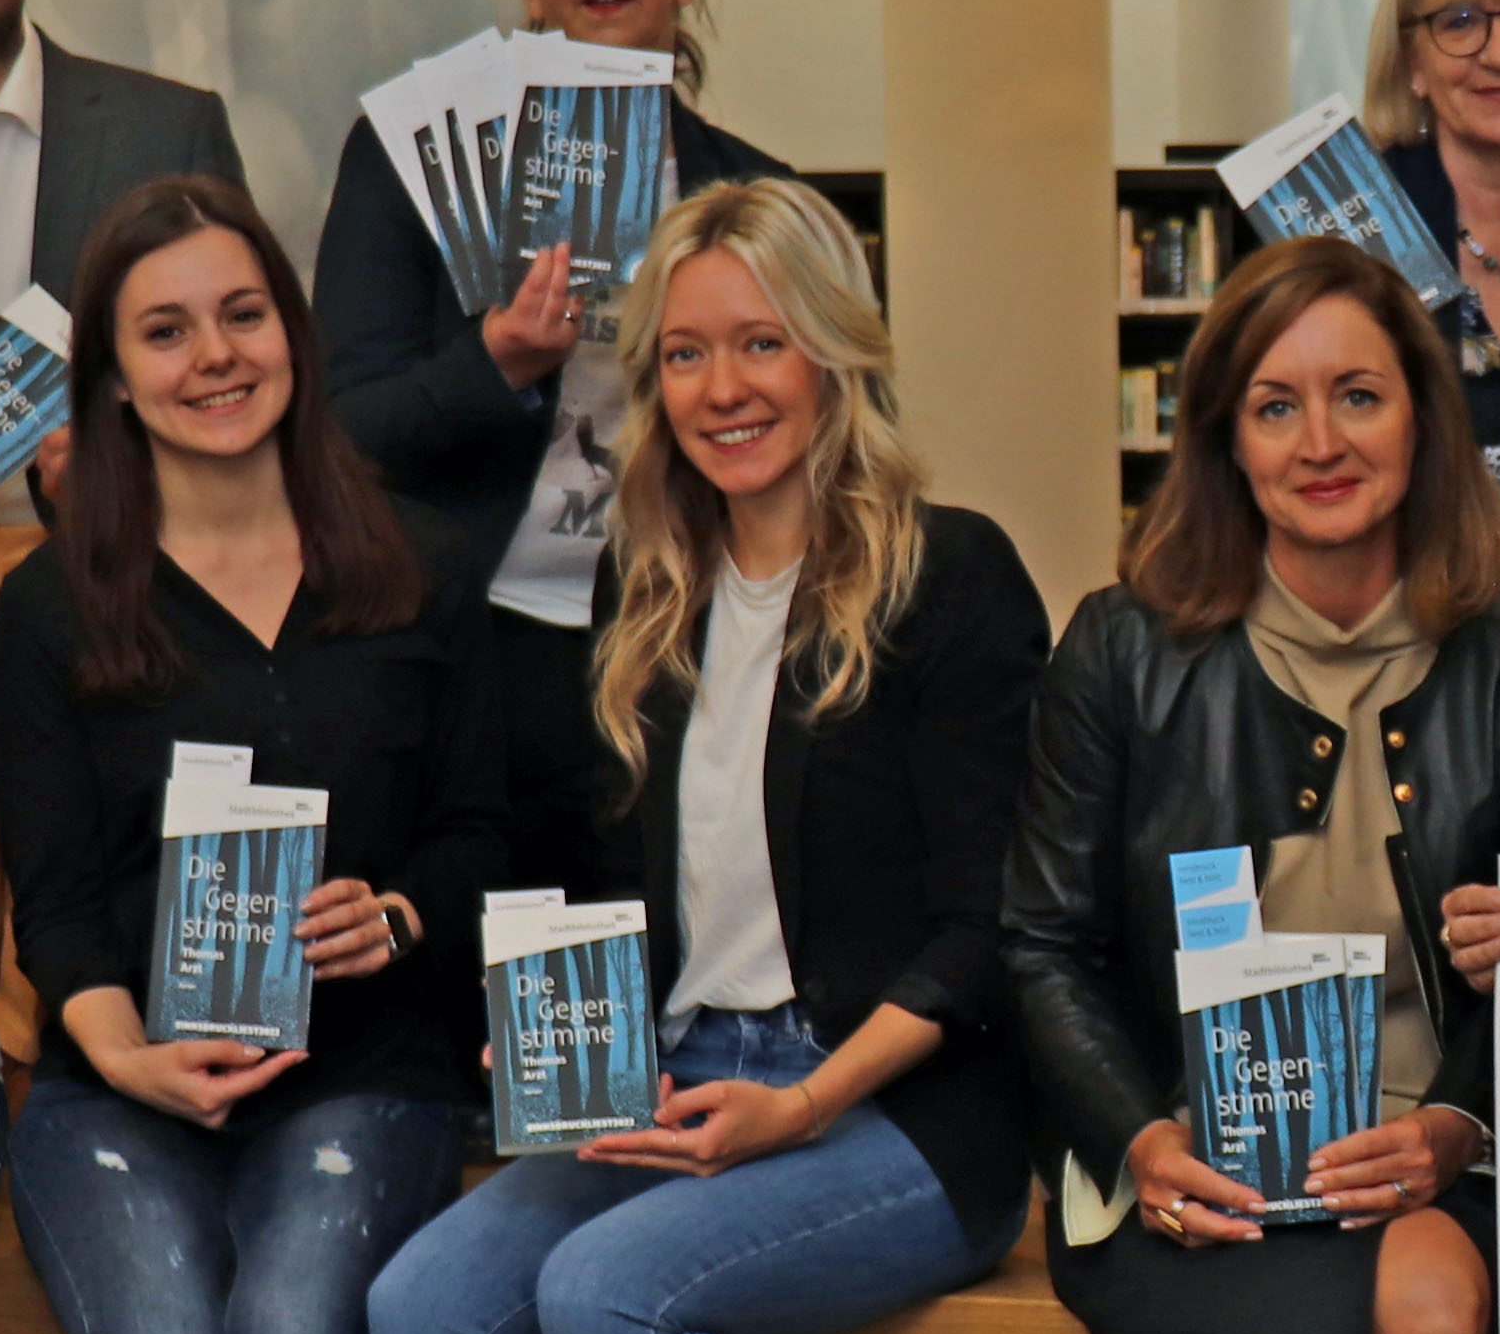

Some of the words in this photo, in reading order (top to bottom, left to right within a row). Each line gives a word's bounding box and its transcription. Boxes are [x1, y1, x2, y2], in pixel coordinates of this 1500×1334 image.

[528, 100, 561, 126] Die
[525, 158, 606, 188] stimme
[1275, 195, 1312, 227] Die
[187, 855, 227, 882] Die
[205, 887, 291, 919] Gegen-
[181, 917, 276, 945] stimme
[515, 973, 555, 997] Die
[539, 997, 629, 1025] Gegen-
[520, 1022, 616, 1050] stimme
[1211, 1026, 1252, 1054] Die
[1236, 1055, 1326, 1088] Gegen-
[1218, 1086, 1316, 1117] stimme
